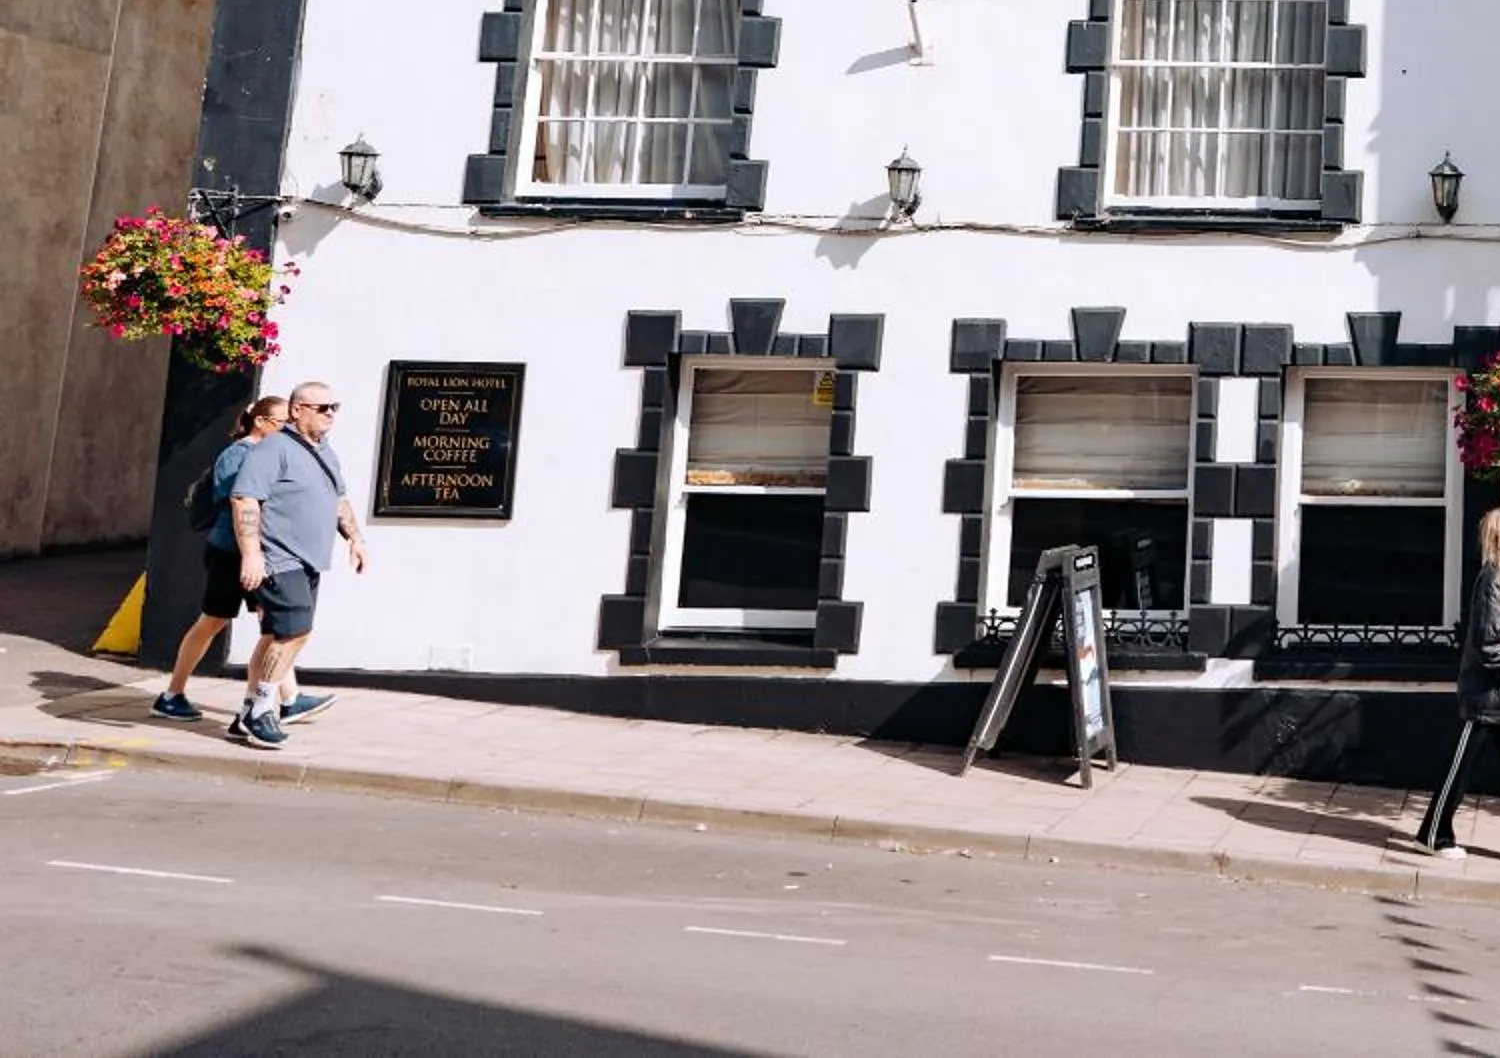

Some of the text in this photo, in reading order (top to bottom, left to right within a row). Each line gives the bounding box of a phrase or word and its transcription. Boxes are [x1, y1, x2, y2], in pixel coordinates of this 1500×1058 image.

[421, 398, 489, 412] OPEN ALL
[440, 412, 469, 425] DAY
[414, 435, 490, 449] MORNING
[423, 449, 477, 462] COFFEE
[402, 473, 493, 486] AFTERNOON
[435, 487, 460, 500] TEA
